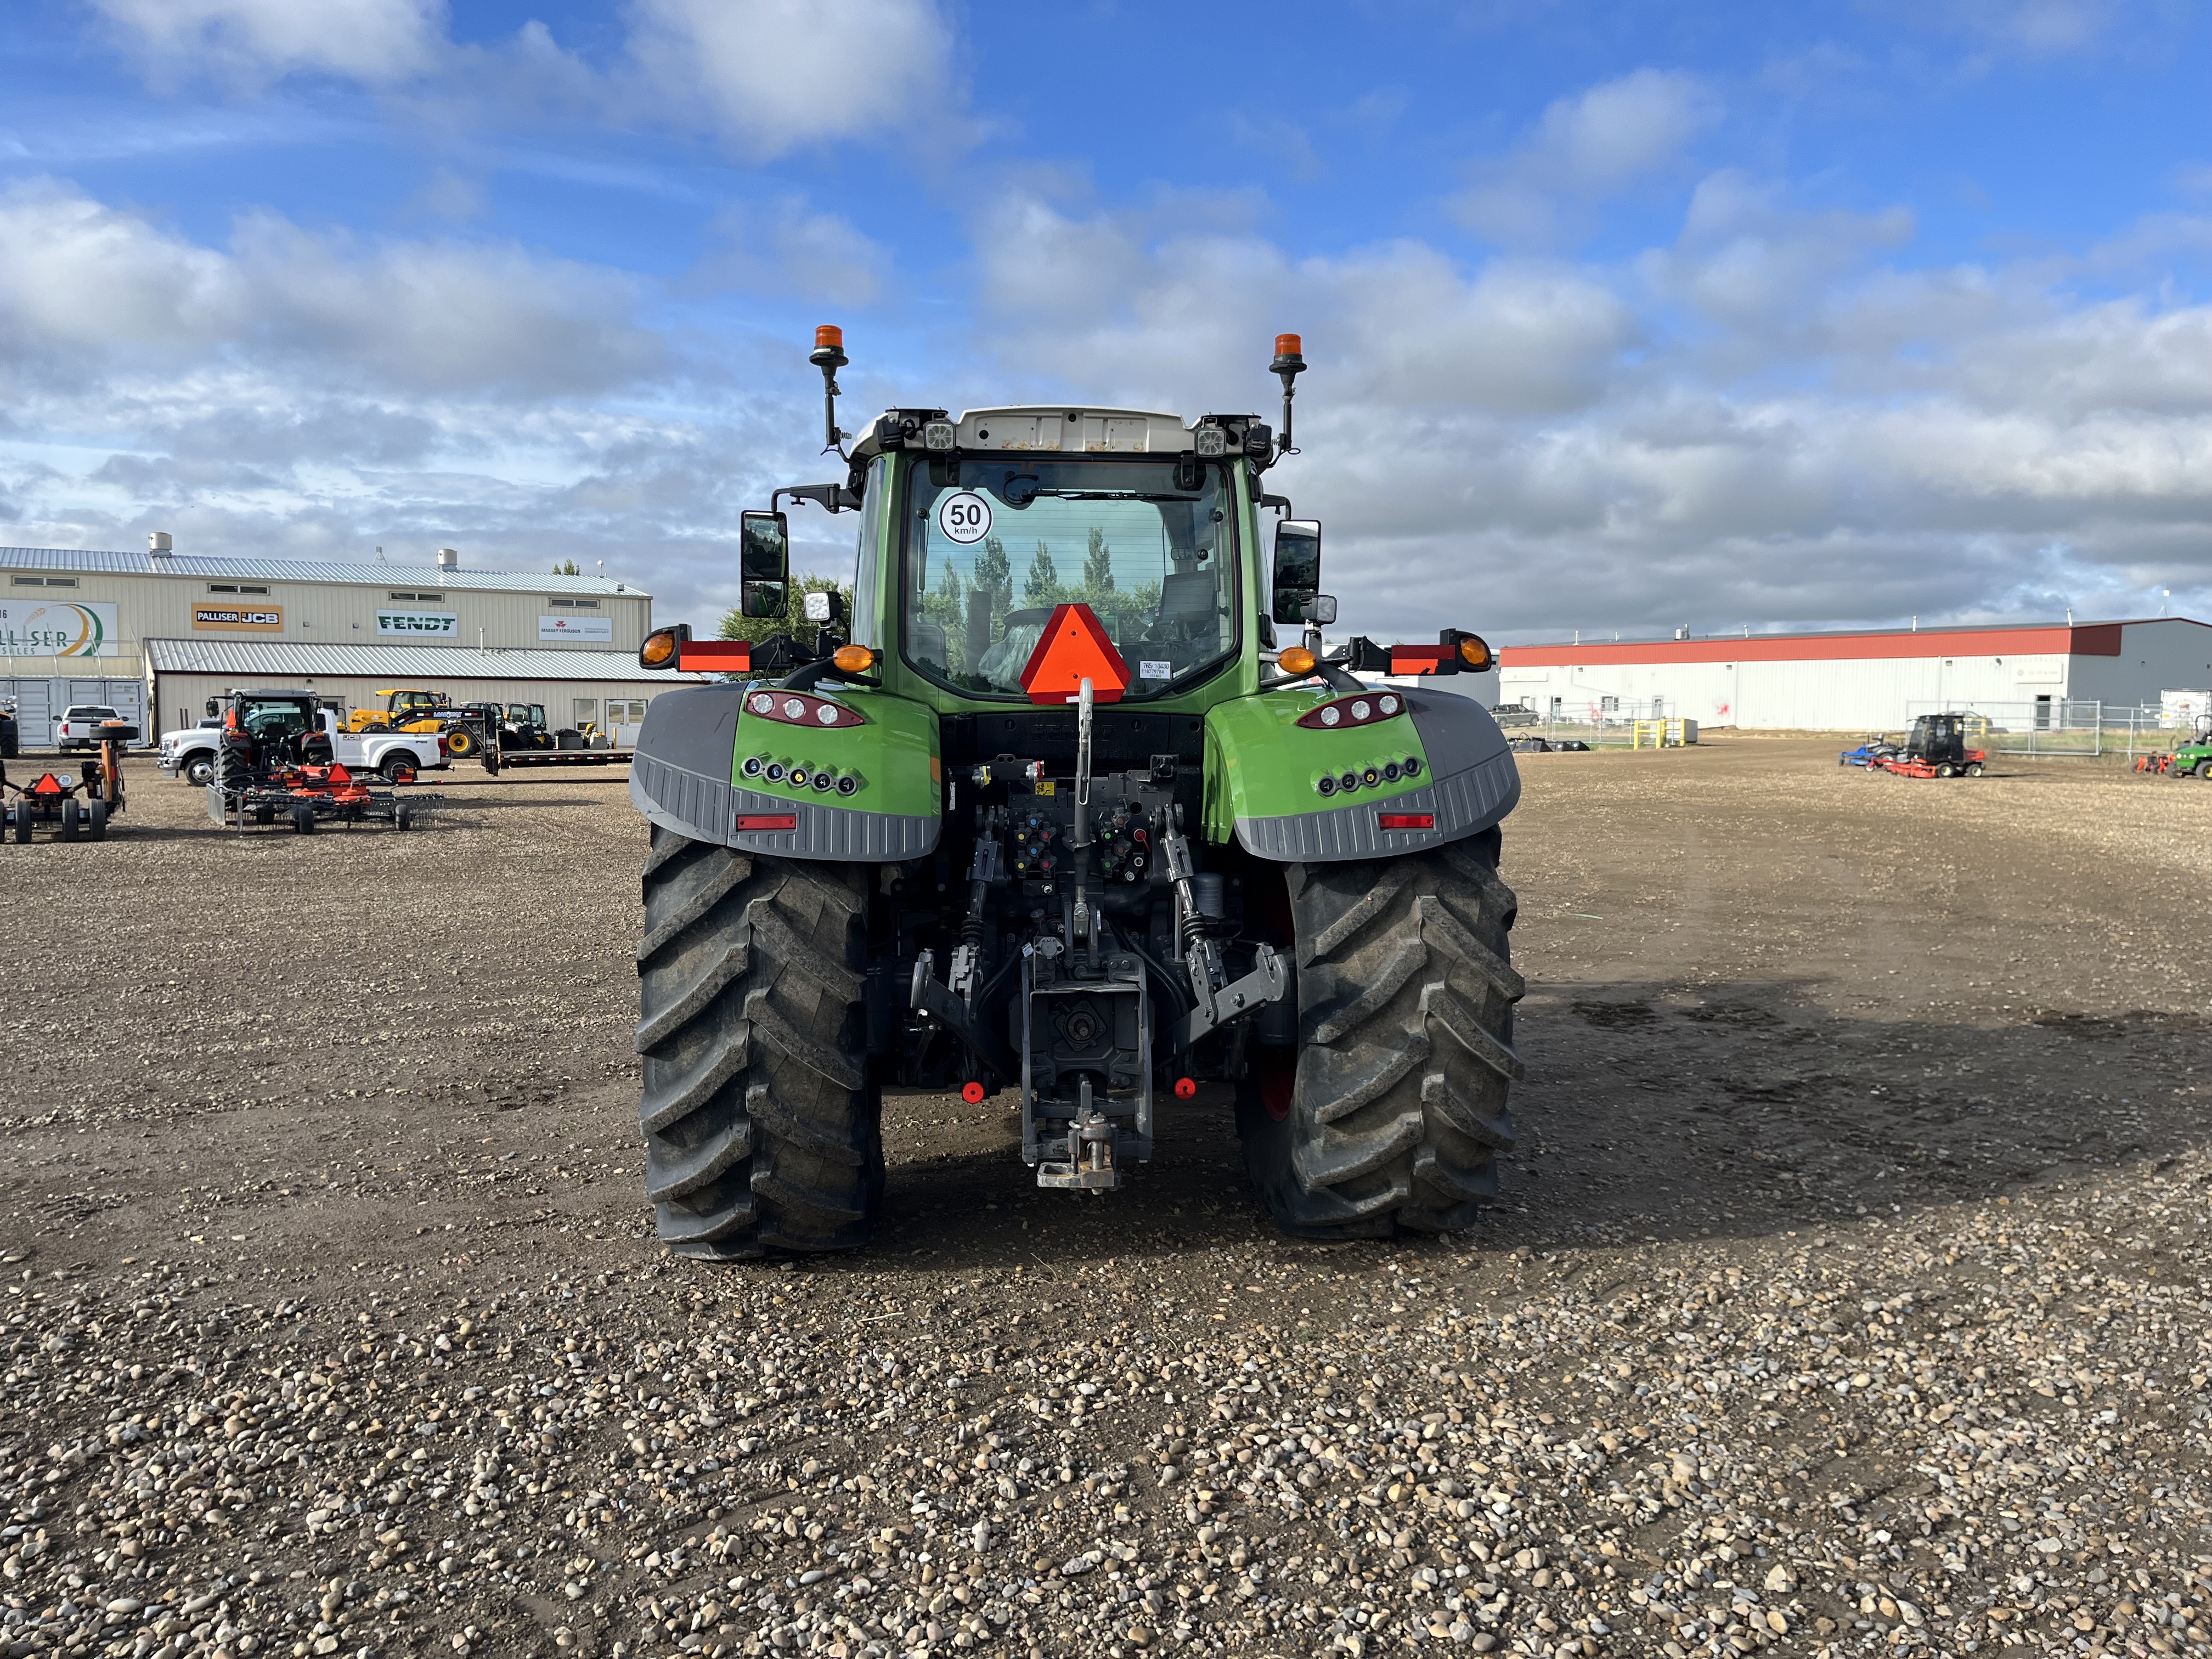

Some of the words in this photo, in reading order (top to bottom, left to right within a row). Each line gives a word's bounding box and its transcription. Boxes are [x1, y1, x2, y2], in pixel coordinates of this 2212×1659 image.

[950, 504, 981, 526] 50
[955, 526, 978, 534] km/h
[198, 612, 238, 622] PALLISER
[241, 613, 278, 623] JCB
[378, 616, 456, 631] FENDT
[2, 647, 35, 655] SLES
